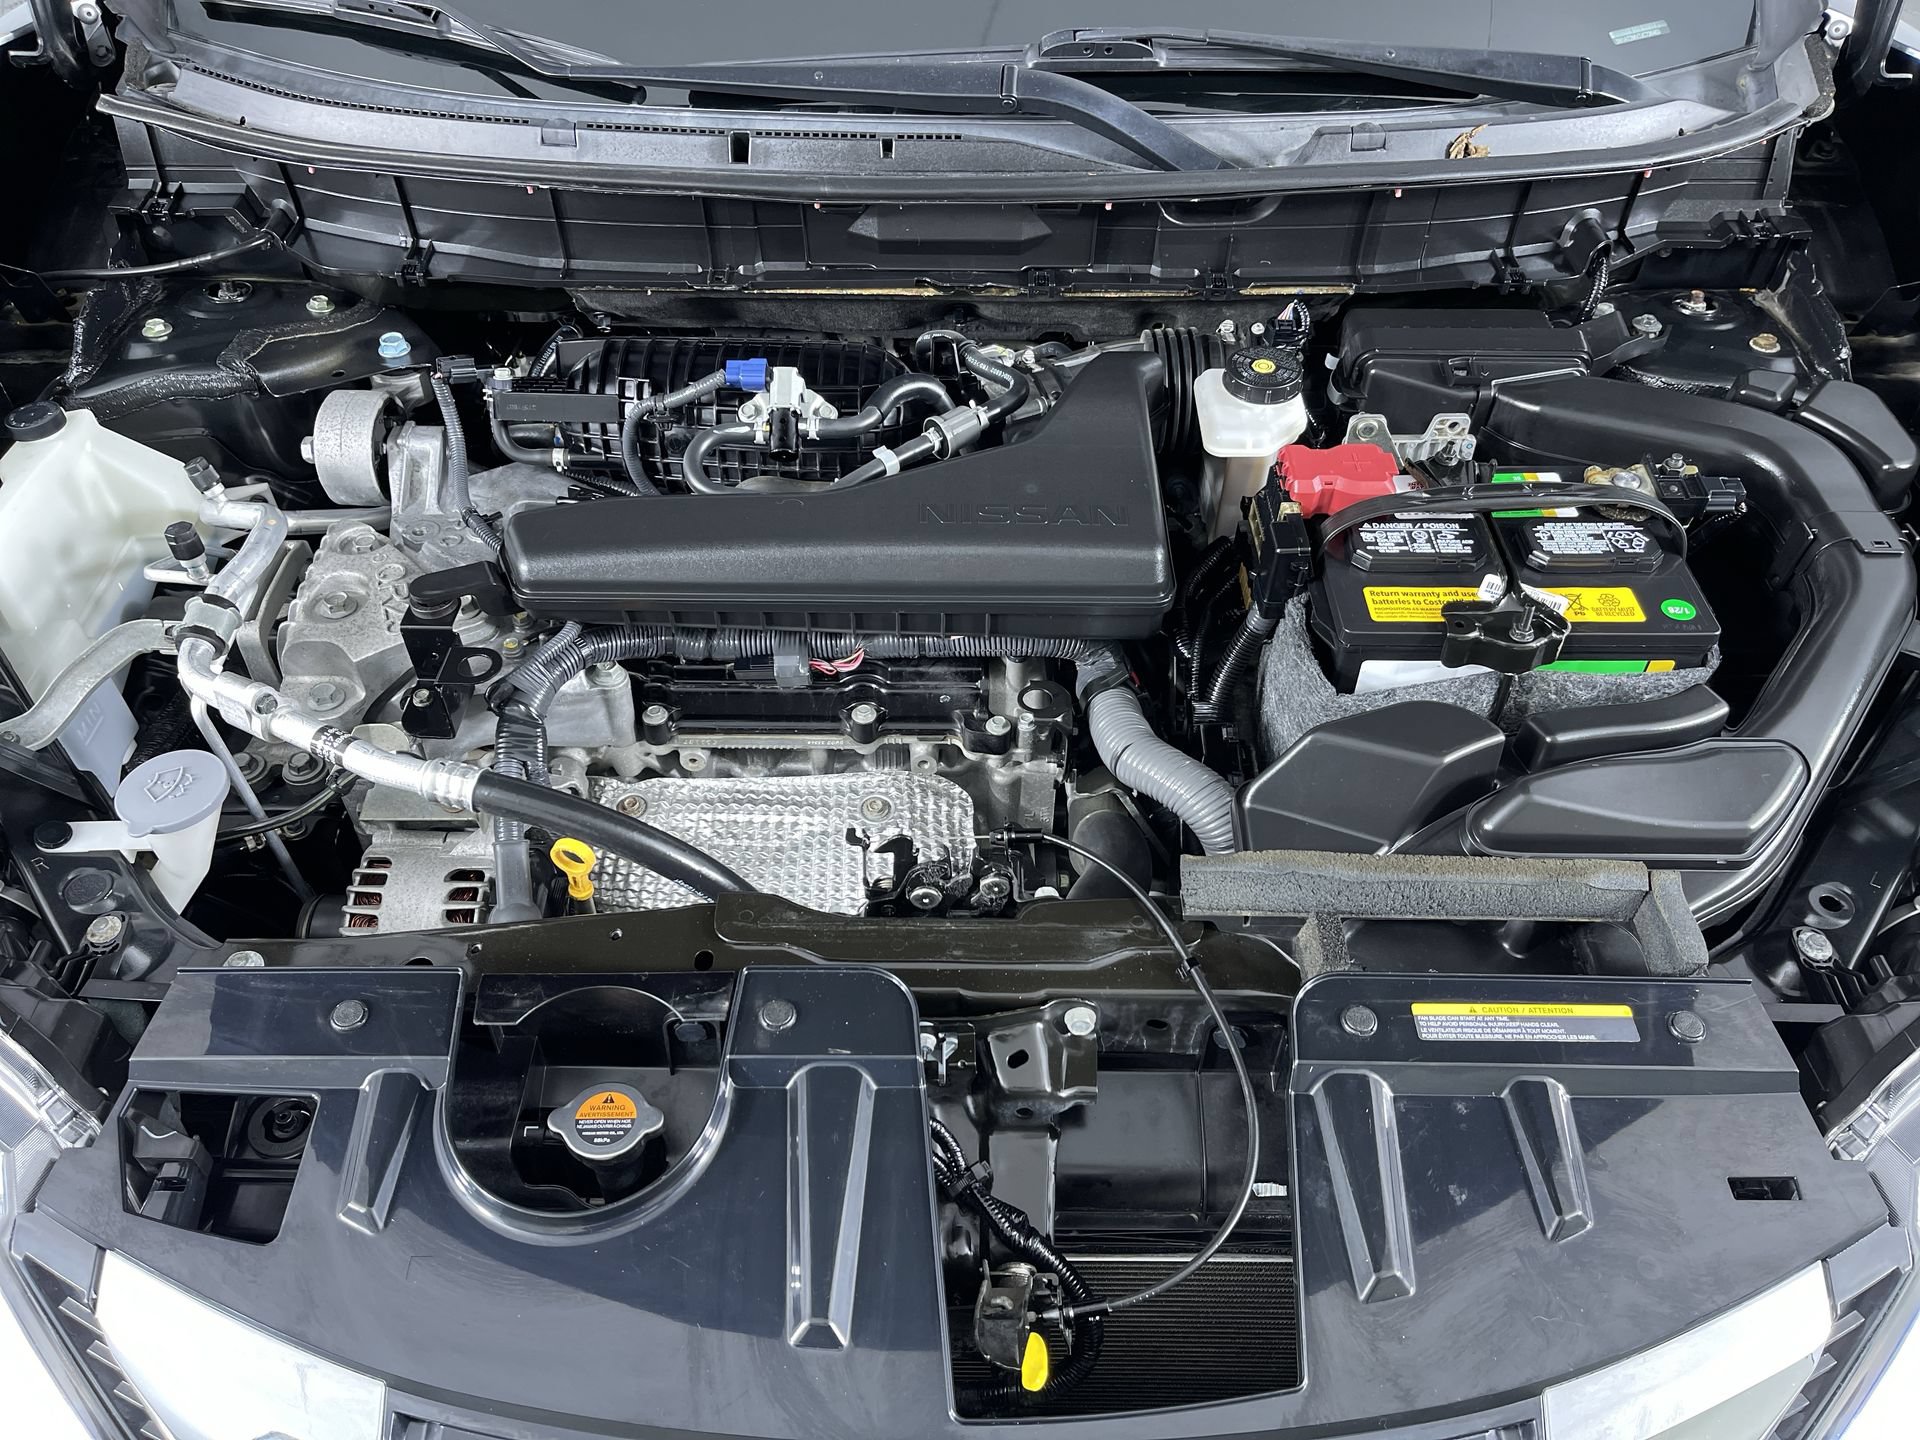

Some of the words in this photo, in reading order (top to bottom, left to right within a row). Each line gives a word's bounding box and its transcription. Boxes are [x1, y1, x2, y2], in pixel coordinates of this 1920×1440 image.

[919, 502, 1129, 526] NISSAN
[1401, 590, 1440, 598] warranty
[77, 702, 101, 740] MIN
